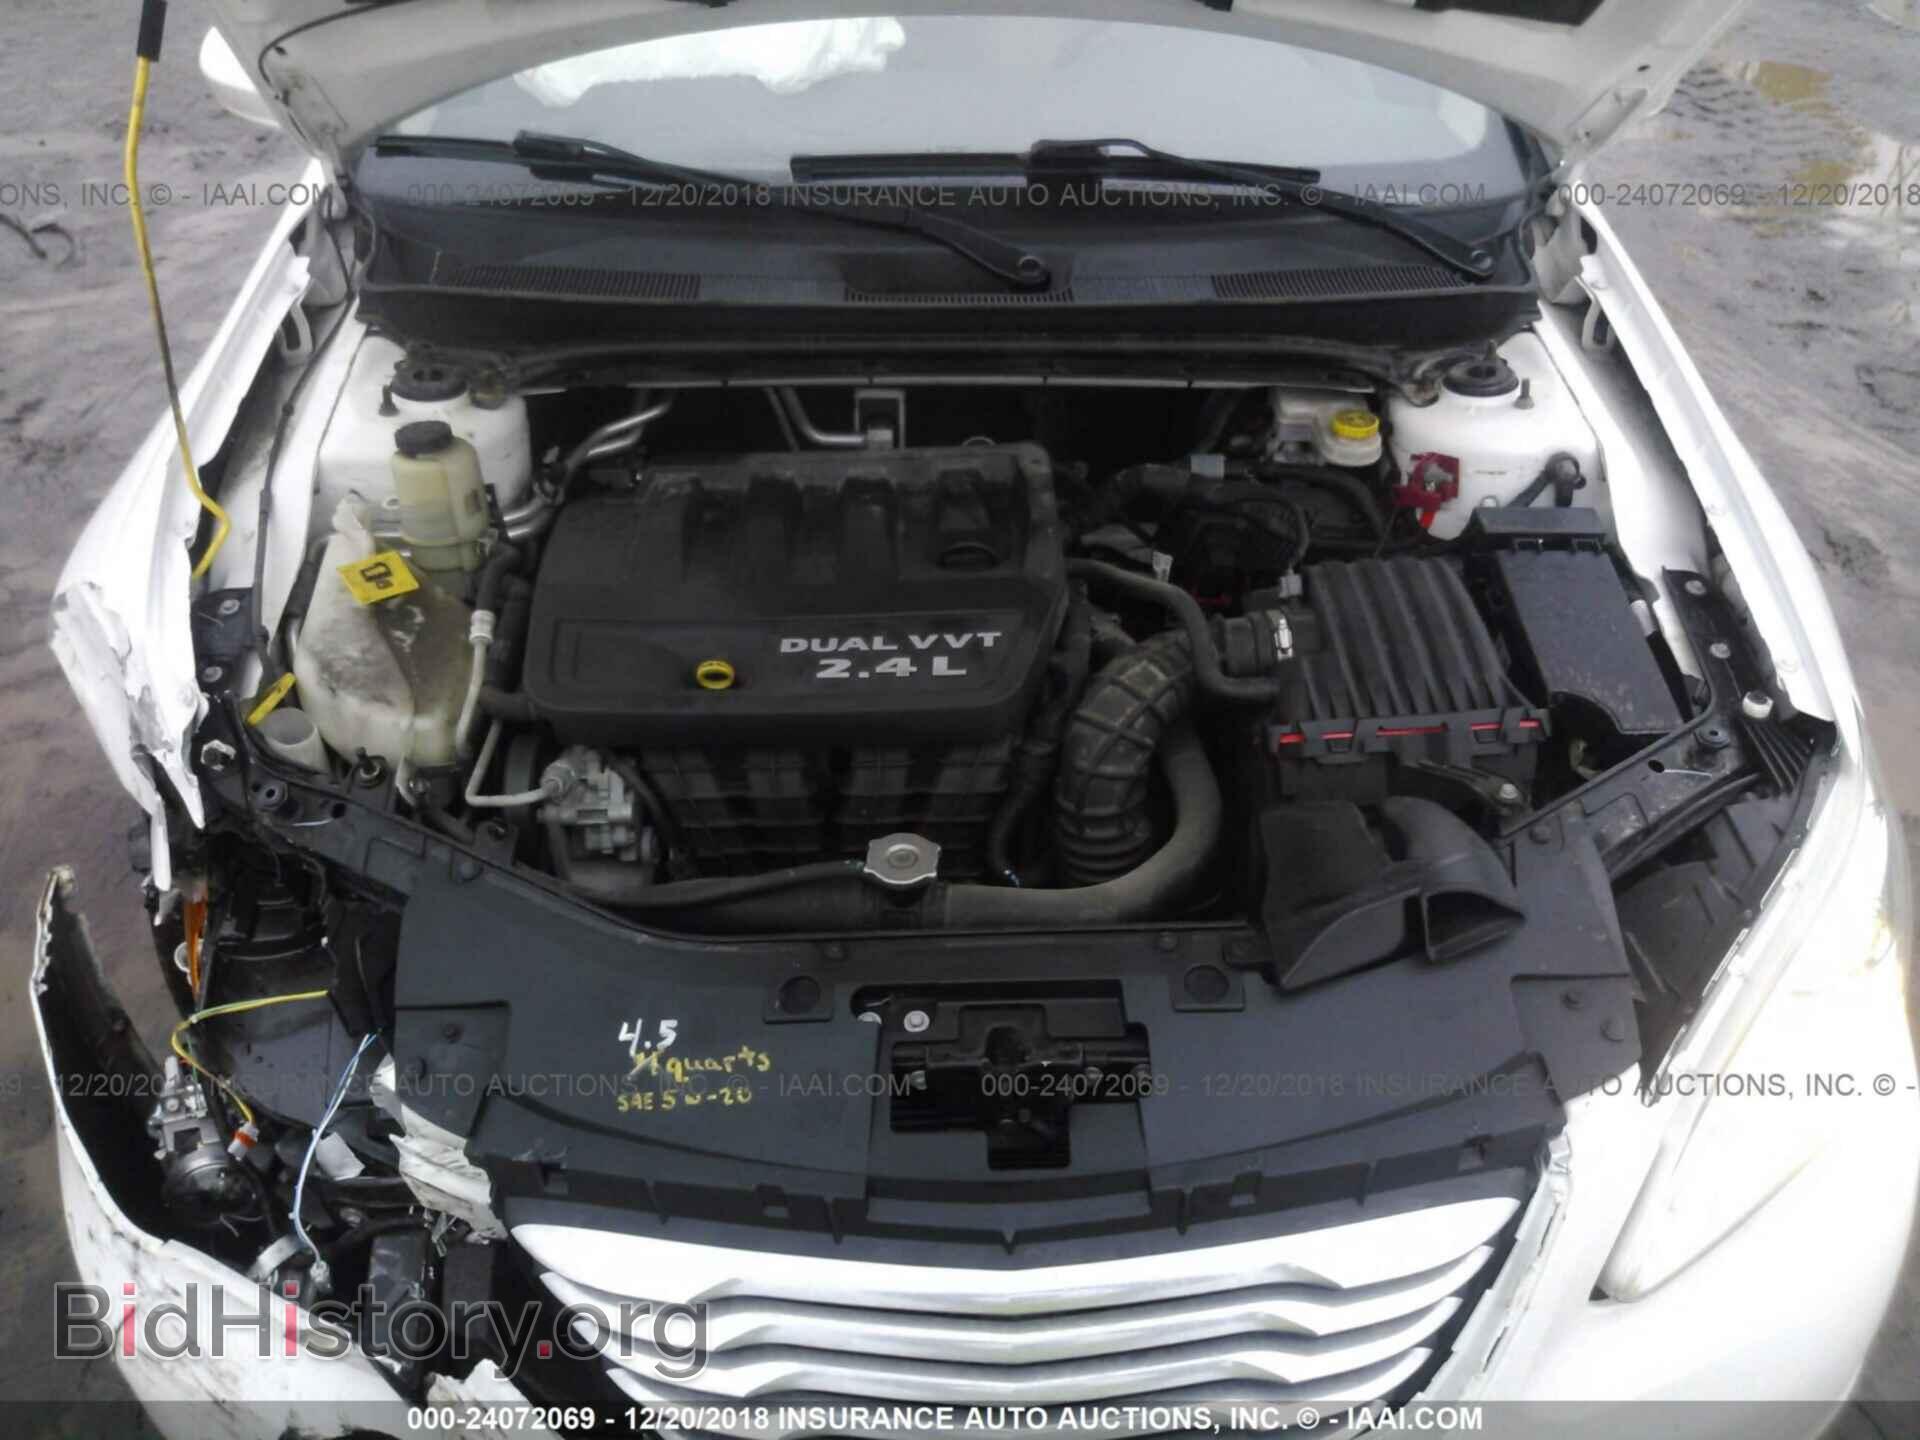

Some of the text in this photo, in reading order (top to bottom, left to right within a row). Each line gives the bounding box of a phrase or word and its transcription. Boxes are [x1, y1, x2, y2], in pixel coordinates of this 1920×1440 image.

[780, 632, 1002, 653] DUAL VVT
[816, 657, 917, 678] 2.4
[618, 1018, 678, 1057] 4.5
[666, 1045, 771, 1083] quarts
[617, 1092, 654, 1112] SAE
